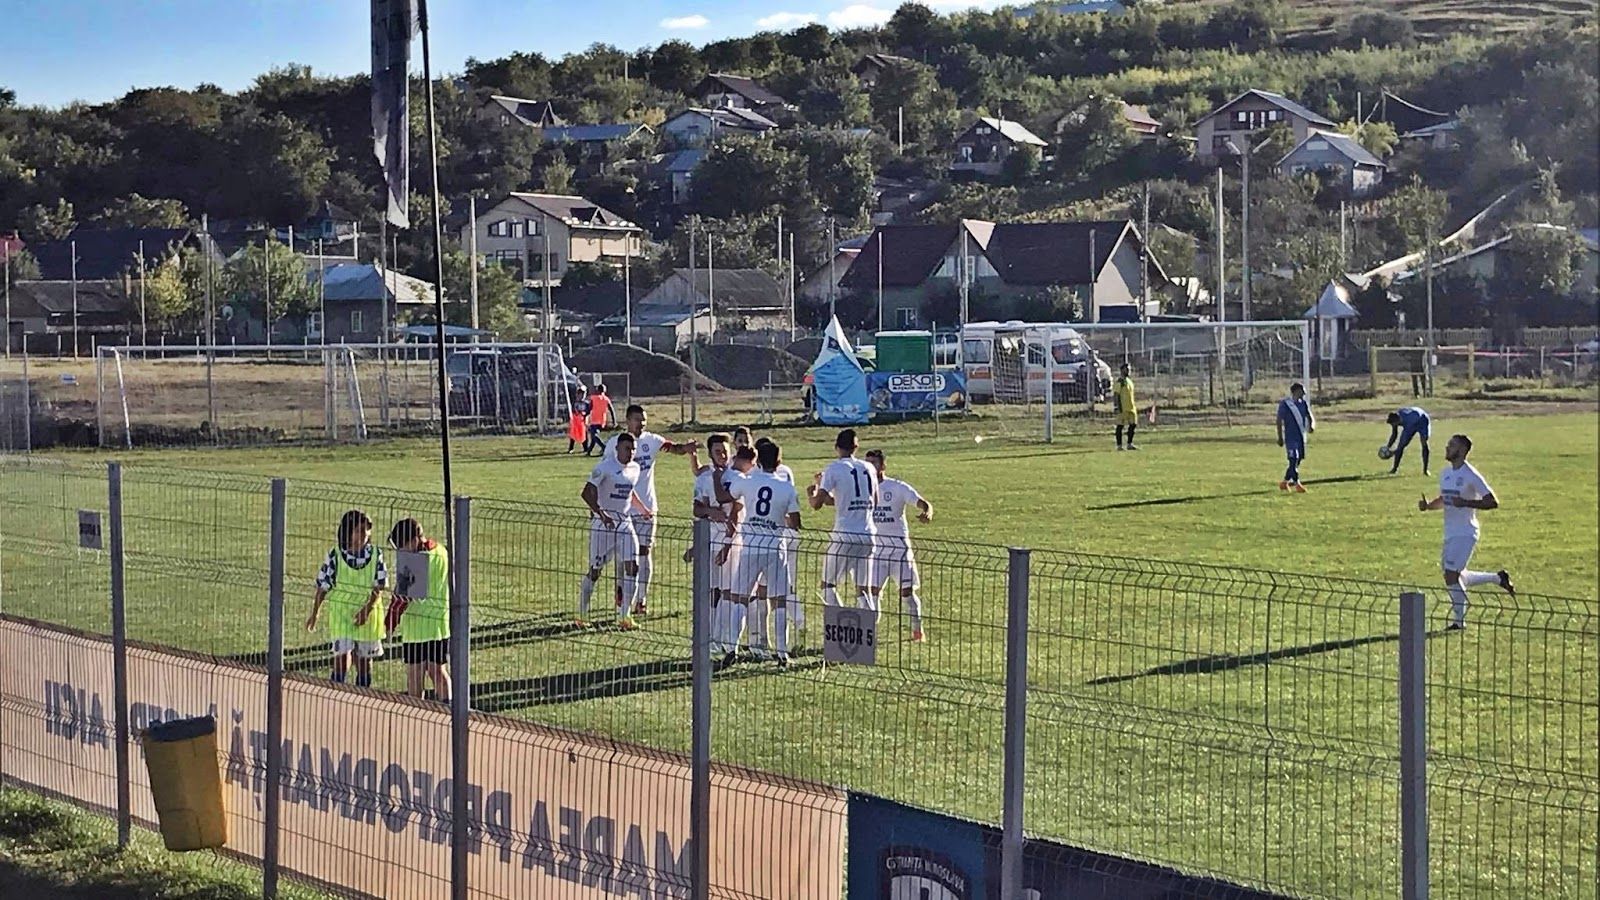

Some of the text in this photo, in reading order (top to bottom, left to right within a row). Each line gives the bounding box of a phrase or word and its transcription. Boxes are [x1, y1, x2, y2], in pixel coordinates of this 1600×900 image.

[892, 375, 942, 386] DEKOR
[850, 468, 872, 497] 11
[755, 486, 772, 516] 8
[825, 624, 873, 647] SECTOR 5
